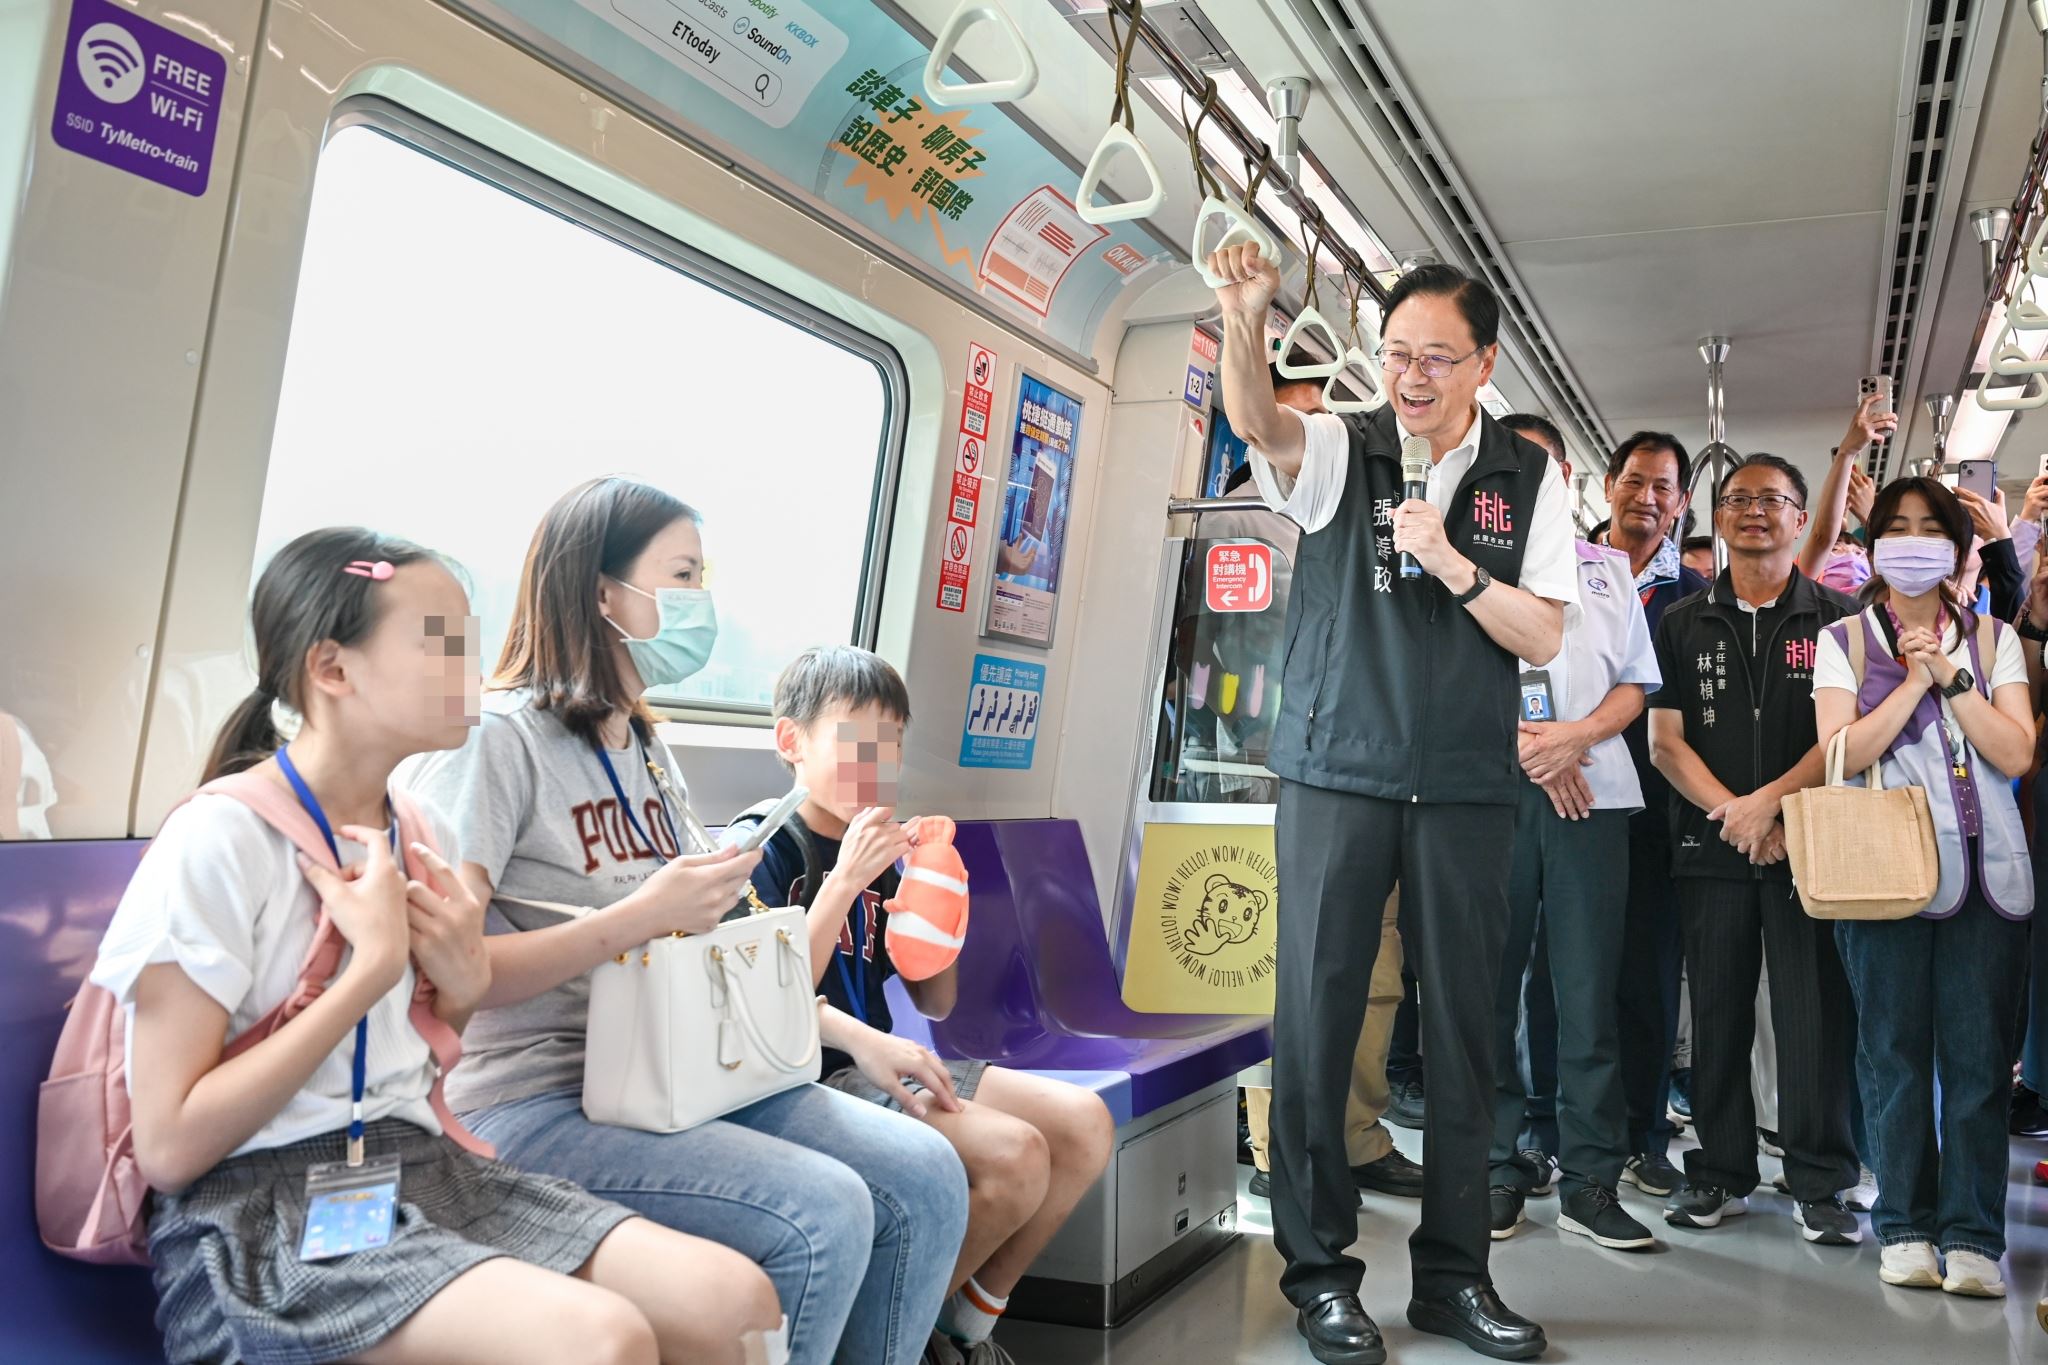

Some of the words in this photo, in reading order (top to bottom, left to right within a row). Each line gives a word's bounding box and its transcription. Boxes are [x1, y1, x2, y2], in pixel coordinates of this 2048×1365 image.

[671, 20, 721, 64] ETtoday
[747, 27, 792, 66] SoundOn
[784, 20, 820, 49] KKBOX
[152, 54, 212, 97] FREE
[150, 92, 203, 133] Wi-Fi
[66, 112, 94, 134] SSID
[99, 121, 200, 174] TyMetro-train
[1201, 336, 1217, 361] 1109
[1190, 377, 1200, 394] 1-2
[1218, 550, 1241, 563] 緊急
[1472, 533, 1514, 547] 桃園市政府
[1212, 563, 1247, 576] 對講機
[1212, 576, 1247, 584] Emergency
[1716, 640, 1727, 690] 主任秘書
[571, 797, 677, 877] POLO
[1162, 876, 1185, 911] WOW!
[1176, 849, 1210, 881] HELLO!
[1211, 845, 1245, 865] WOW!
